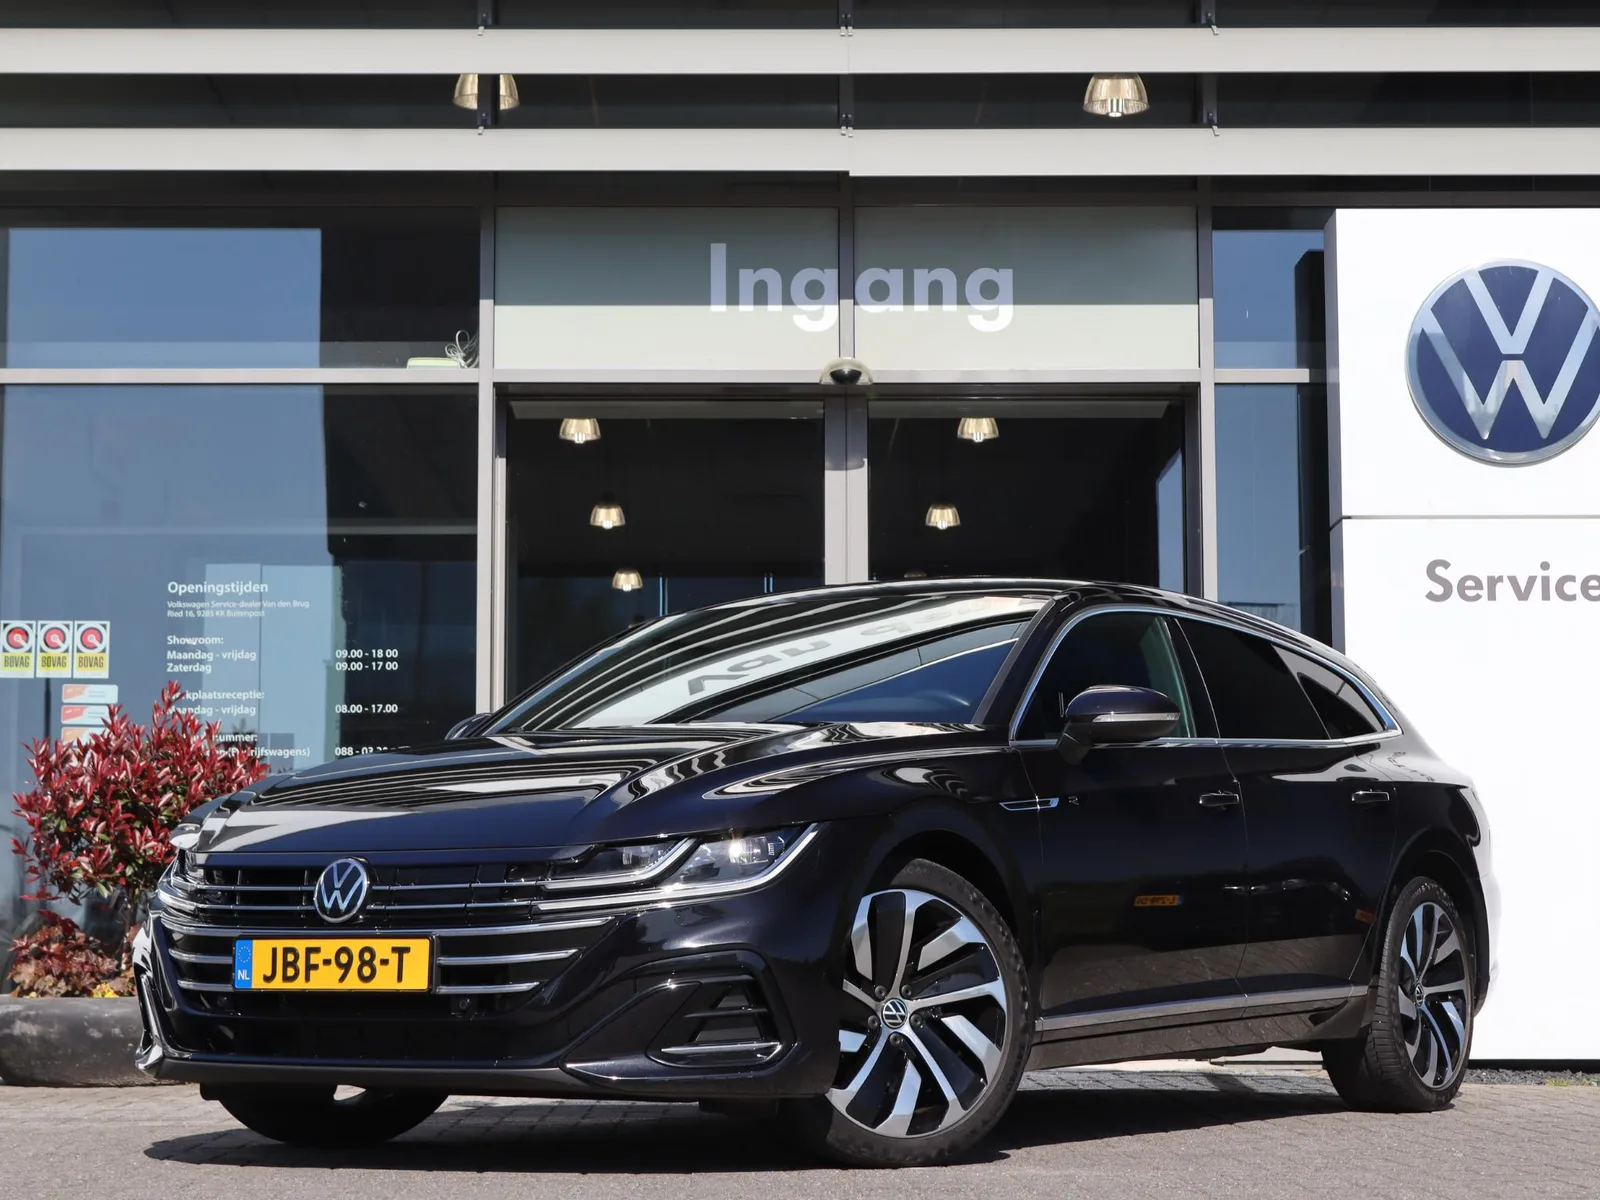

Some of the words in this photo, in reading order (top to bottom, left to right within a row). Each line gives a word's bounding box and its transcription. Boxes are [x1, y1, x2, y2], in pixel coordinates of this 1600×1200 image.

[710, 243, 1014, 332] Ingang
[1425, 559, 1600, 602] Service
[167, 581, 268, 596] Openingstijden
[167, 601, 209, 609] Volkswagen
[262, 600, 276, 608] Van
[277, 600, 291, 608] den
[292, 600, 310, 609] Brug
[167, 635, 224, 645] Showroom:
[166, 649, 213, 661] Maandag
[221, 650, 257, 661] vrijdag
[335, 649, 363, 658] 09.00
[4, 656, 30, 667] BOVAG
[41, 656, 67, 667] BOVAG
[78, 656, 104, 668] BOVAG
[166, 662, 212, 674] Zaterdag
[335, 661, 363, 671] 09.00
[221, 704, 256, 716] vrijdag
[335, 704, 363, 713] 08.00
[371, 704, 398, 713] 17.00
[334, 747, 353, 756] 088
[237, 969, 250, 981] NL
[262, 945, 412, 984] JBF-98-T
